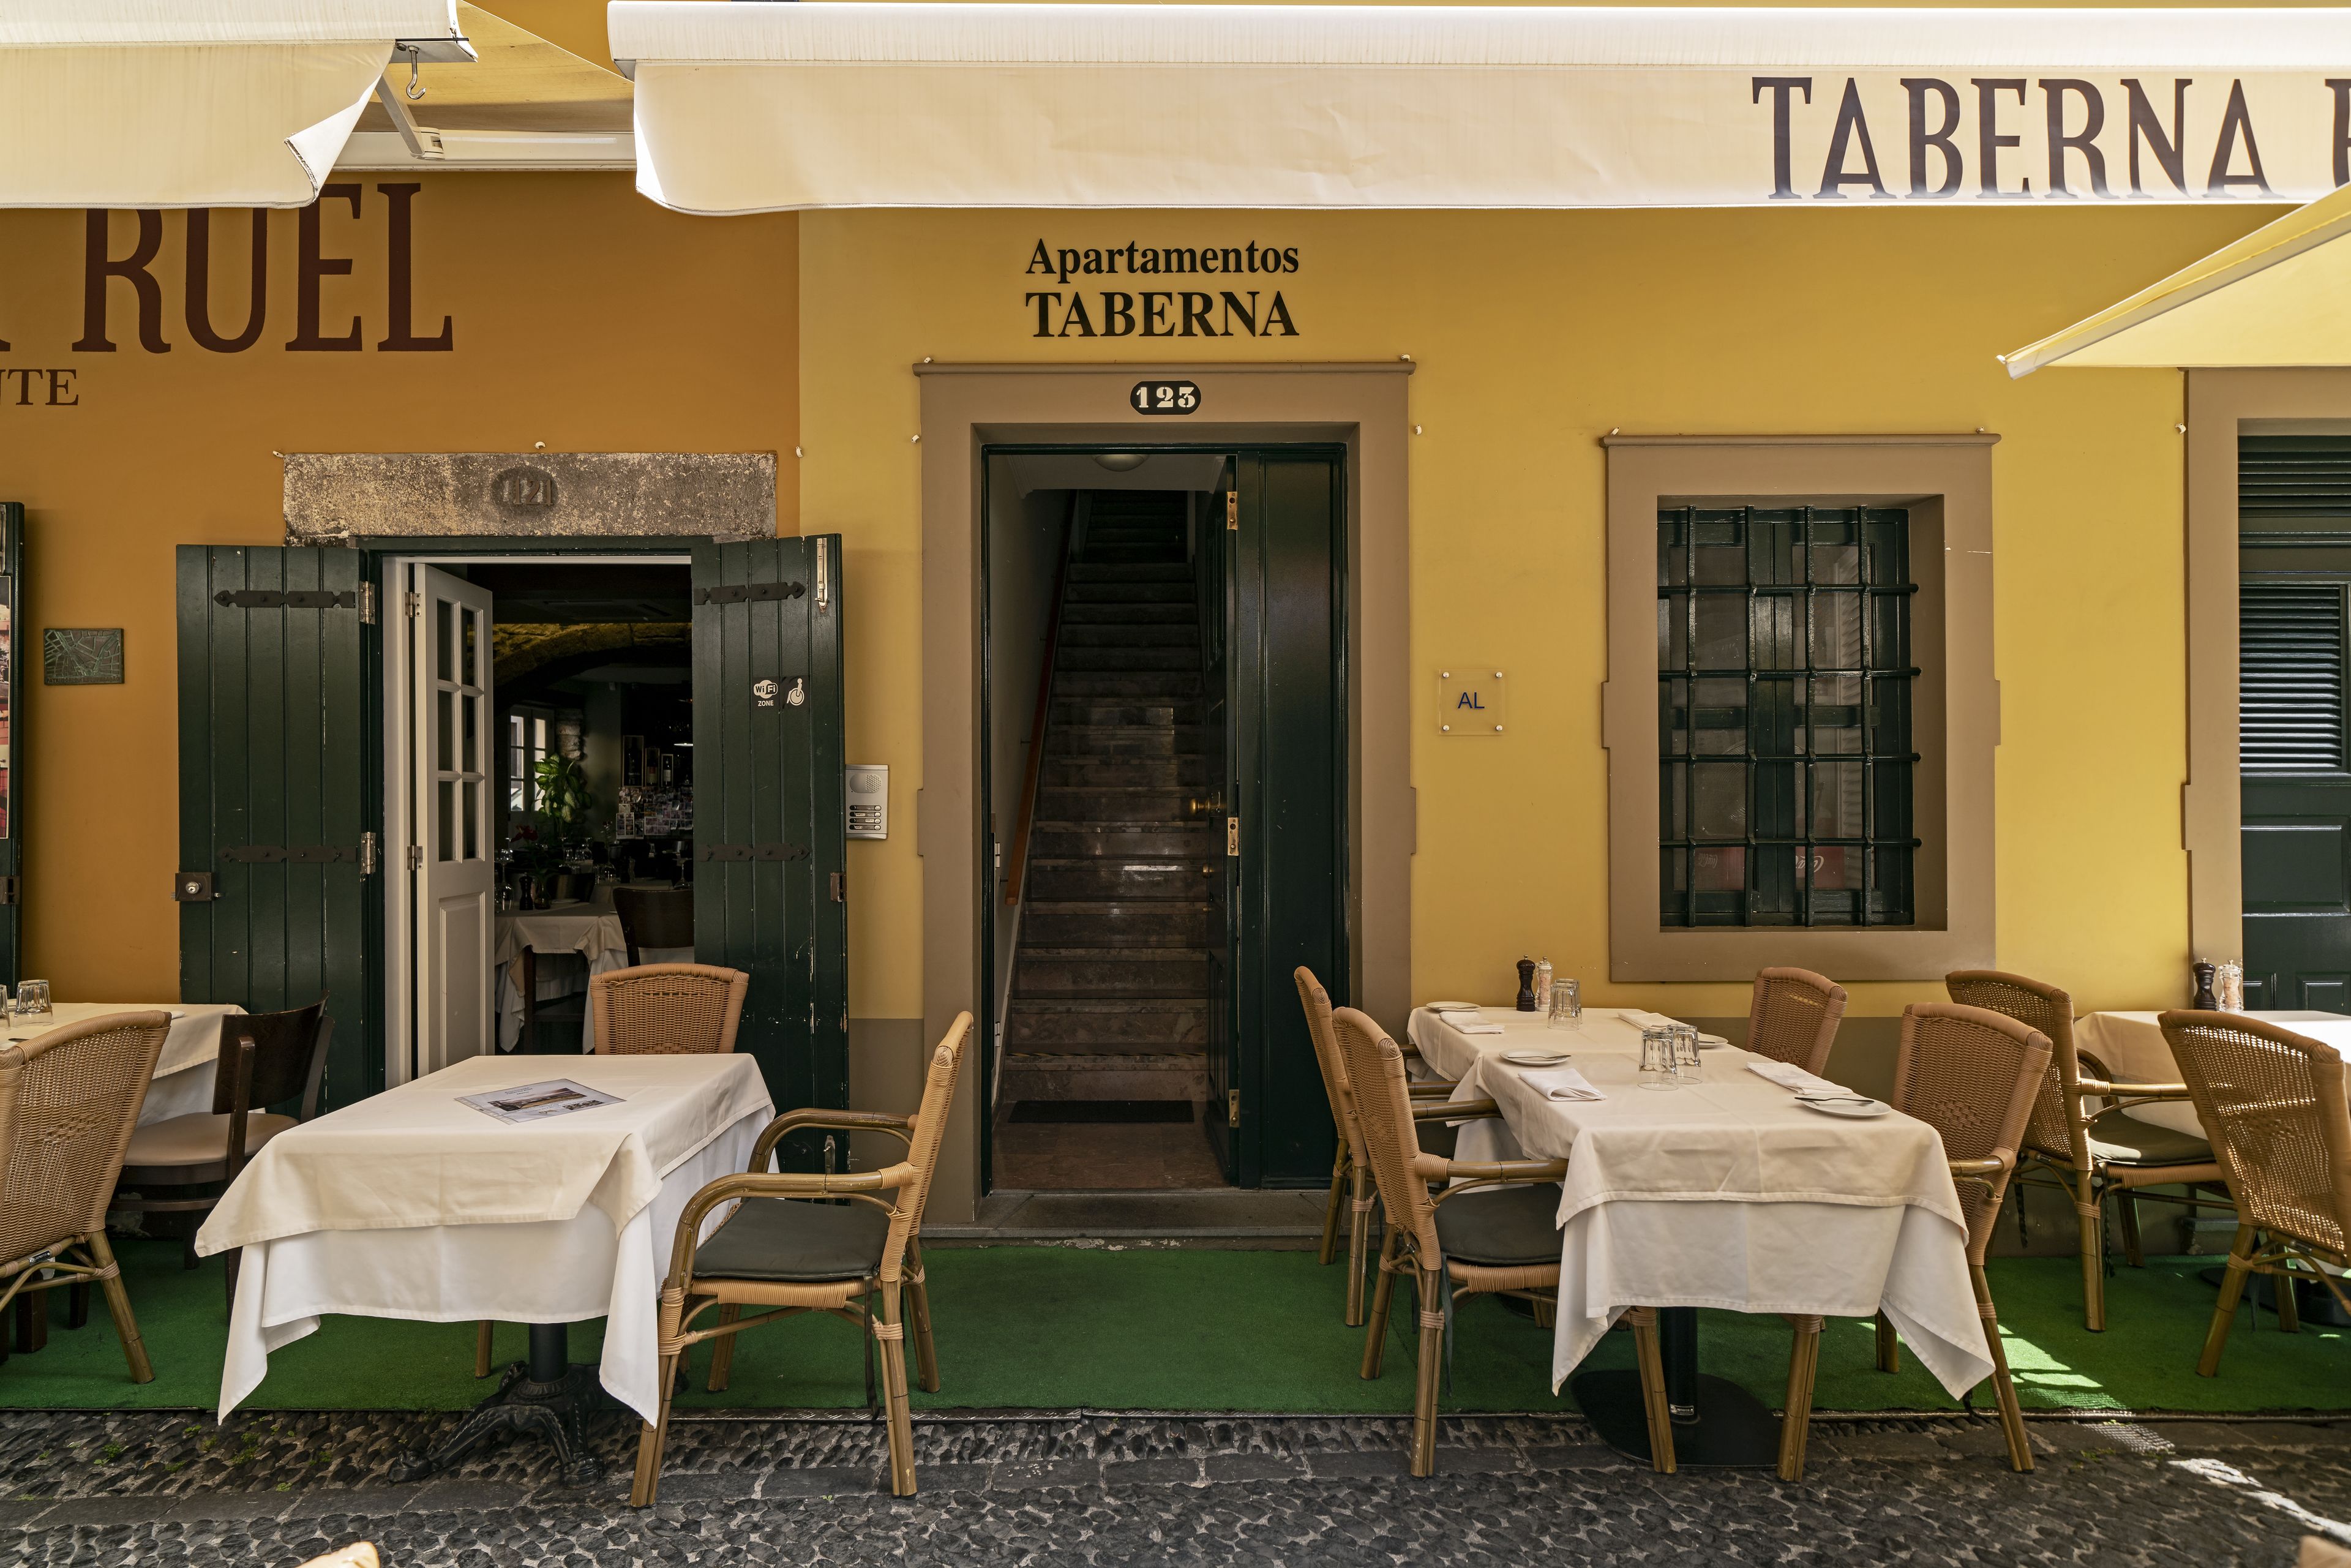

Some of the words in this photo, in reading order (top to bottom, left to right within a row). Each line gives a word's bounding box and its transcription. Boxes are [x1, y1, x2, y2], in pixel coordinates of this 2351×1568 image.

[1752, 77, 2286, 200] TABERNA
[72, 182, 454, 353] RUEL
[1026, 238, 1299, 284] Apartamentos
[1026, 290, 1300, 337] TABERNA
[0, 369, 79, 406] TE
[1136, 386, 1196, 408] 123
[514, 479, 554, 505] 121
[1457, 692, 1485, 709] AL
